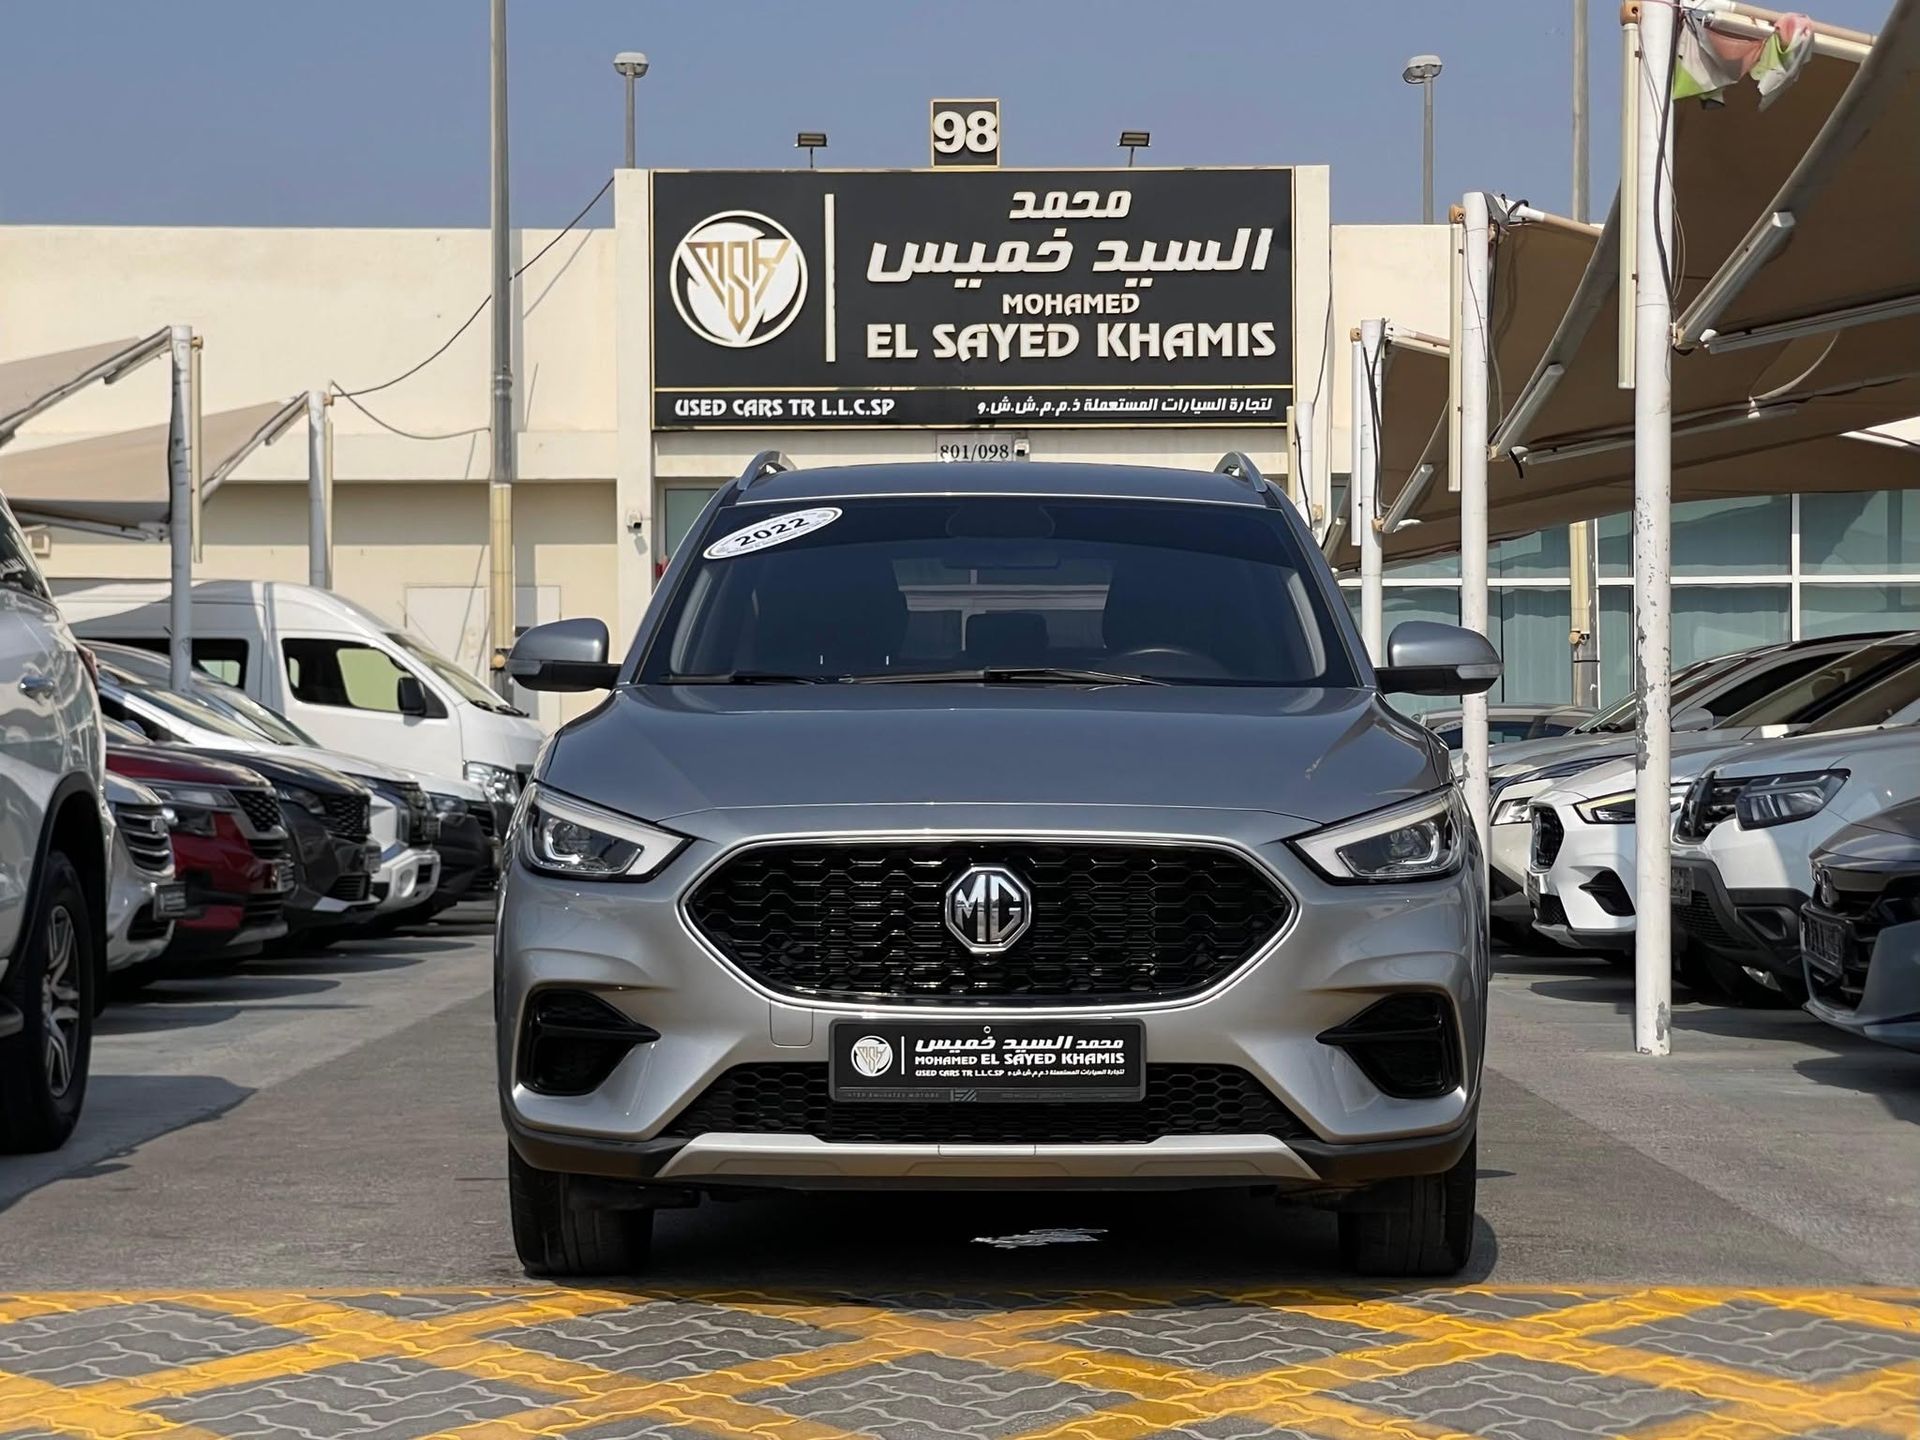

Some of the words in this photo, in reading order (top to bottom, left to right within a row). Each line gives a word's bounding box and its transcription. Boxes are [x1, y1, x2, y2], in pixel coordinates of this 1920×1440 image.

[933, 110, 998, 154] 98
[1009, 190, 1132, 219] محمد
[866, 227, 1074, 288] خميس
[1092, 227, 1273, 288] السيد
[1002, 293, 1140, 317] MOHAMED
[867, 323, 919, 358] EL
[933, 323, 1080, 362] SAYED
[1098, 322, 1276, 362] KHAMIS
[675, 398, 727, 417] USED
[732, 398, 784, 418] CARS
[788, 398, 816, 418] TR
[821, 398, 895, 416] L.L.C.SP
[1083, 397, 1159, 412] المستعملة
[1160, 397, 1228, 415] السيارات
[1228, 397, 1273, 414] لتجارة
[735, 517, 810, 547] 2022
[955, 874, 1021, 942] MG
[915, 1036, 996, 1054] خميس
[1002, 1035, 1074, 1053] السيد
[1075, 1039, 1124, 1049] محمد
[914, 1055, 978, 1066] MOHAMED
[980, 1053, 1000, 1065] EL
[1004, 1053, 1057, 1066] SAYED
[1061, 1052, 1125, 1066] KHAMIS
[915, 1069, 938, 1077] USED
[938, 1069, 960, 1077] CARS
[961, 1069, 974, 1077] TR
